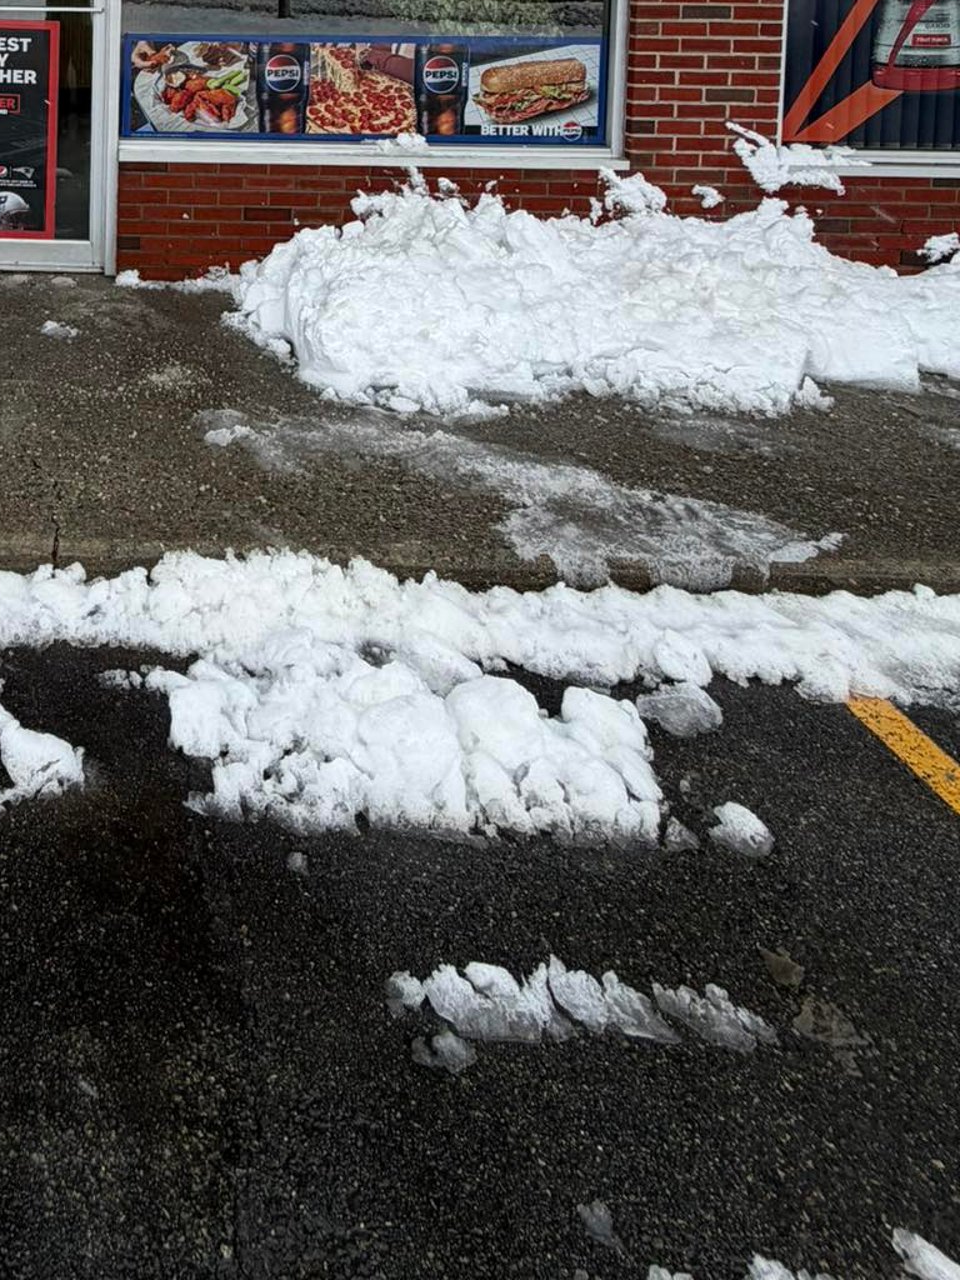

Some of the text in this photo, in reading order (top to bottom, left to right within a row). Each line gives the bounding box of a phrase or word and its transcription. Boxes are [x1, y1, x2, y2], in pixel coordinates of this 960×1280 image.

[267, 68, 300, 78] PEPSI
[423, 68, 458, 80] PEPSI
[480, 123, 529, 136] BETTER
